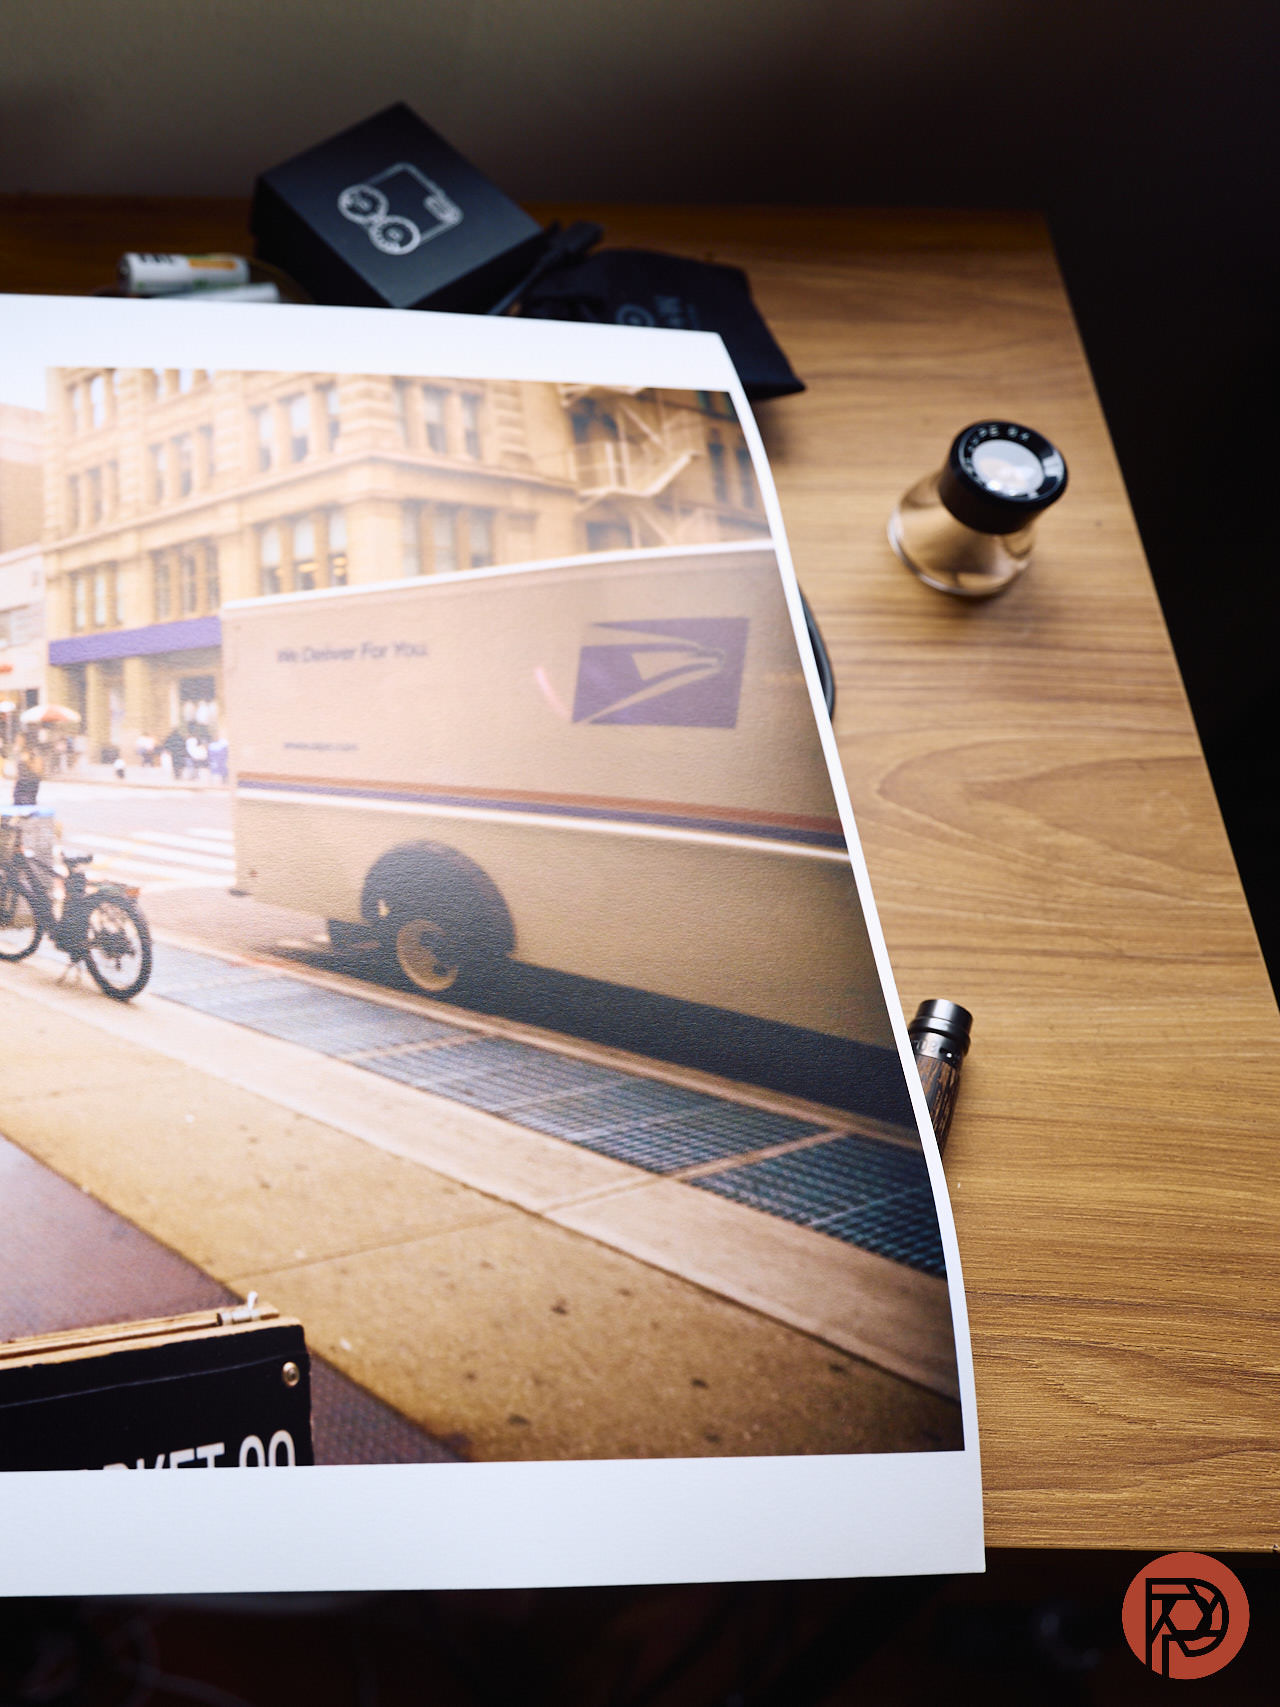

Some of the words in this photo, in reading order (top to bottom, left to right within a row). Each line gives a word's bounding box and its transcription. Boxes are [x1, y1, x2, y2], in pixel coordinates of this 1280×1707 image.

[276, 647, 299, 663] We
[302, 645, 357, 663] Deliver
[360, 642, 388, 660] For
